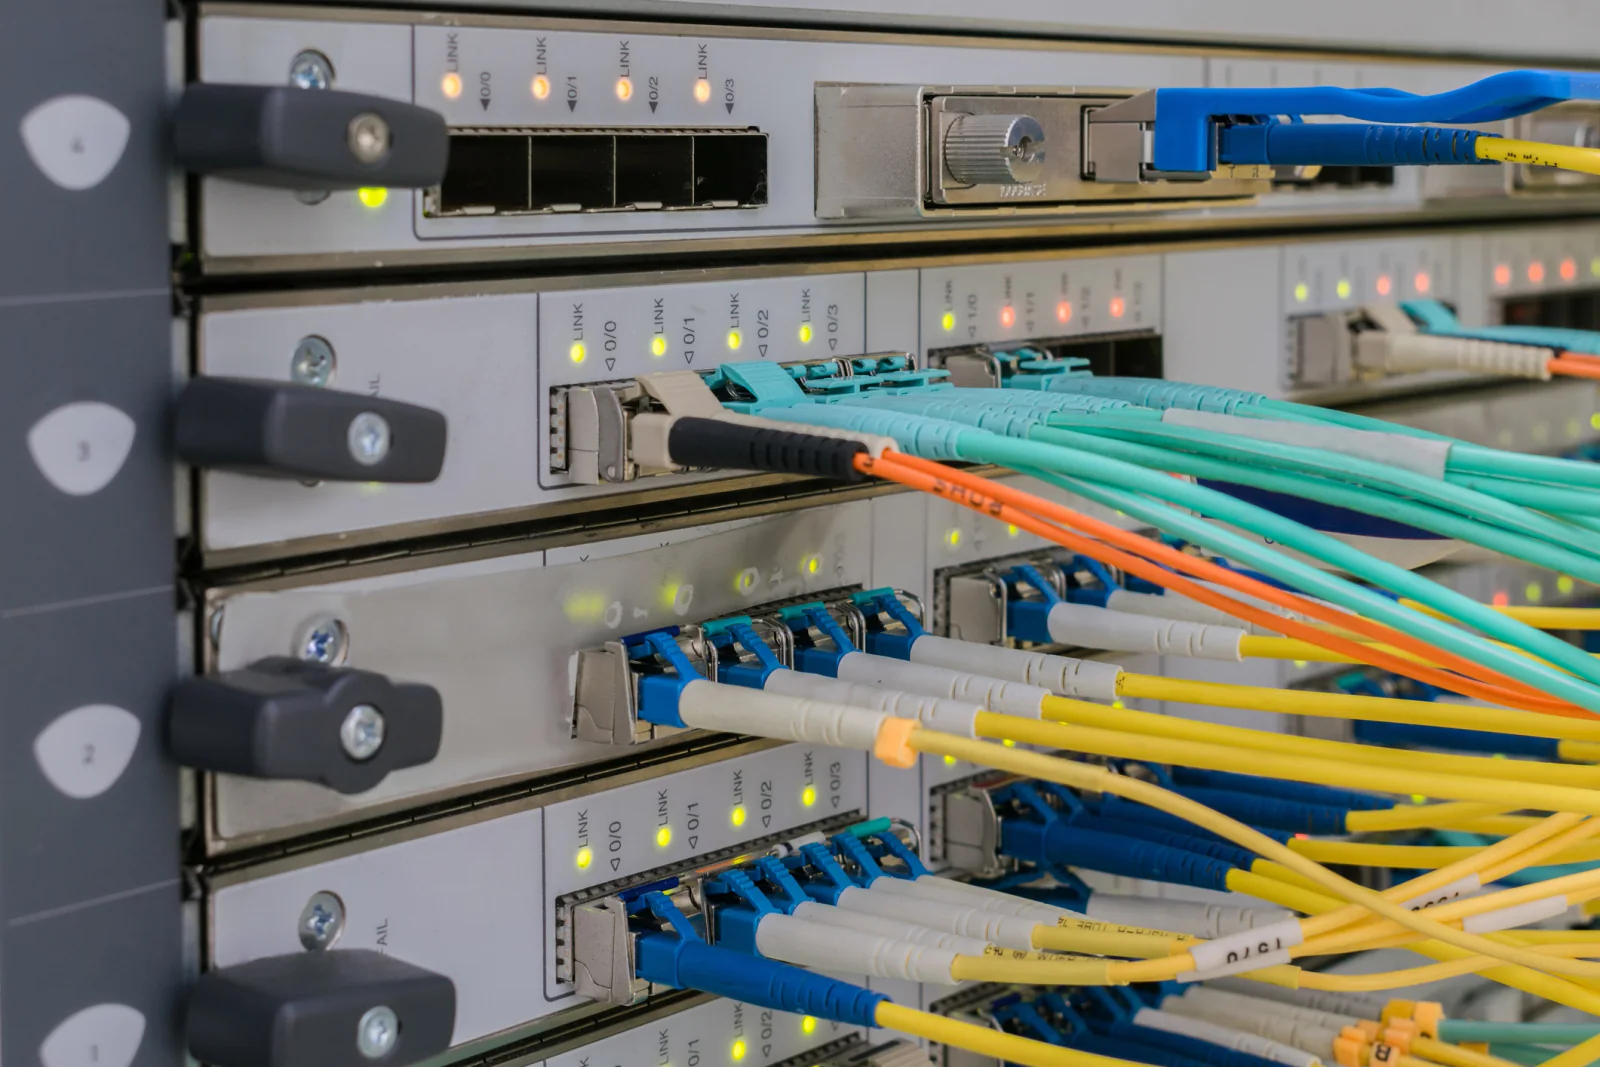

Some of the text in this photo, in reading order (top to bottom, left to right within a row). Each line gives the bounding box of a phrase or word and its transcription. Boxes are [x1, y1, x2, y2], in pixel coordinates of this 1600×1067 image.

[447, 33, 459, 73] LINK
[536, 36, 547, 75] LINK
[619, 40, 630, 77] LINK
[698, 43, 708, 80] LINK
[480, 71, 492, 98] 0/0
[567, 76, 578, 99] 0/1
[648, 76, 659, 101] 0/2
[725, 78, 735, 102] 0/3
[573, 302, 583, 341] LINK
[654, 297, 664, 334] LINK
[730, 292, 740, 329] LINK
[801, 288, 811, 323] LINK
[828, 304, 838, 333] 0/3
[604, 320, 617, 352] 0/0
[683, 317, 695, 345] 0/1
[757, 309, 769, 338] 0/2
[804, 751, 813, 786] LINK
[830, 761, 841, 791] 0/3
[734, 769, 743, 806] LINK
[761, 780, 772, 810] 0/2
[658, 789, 668, 827] LINK
[687, 802, 699, 831] 0/1
[578, 809, 589, 848] LINK
[609, 820, 621, 852] 0/0
[734, 1002, 743, 1039] LINK
[659, 1028, 669, 1065] LINK
